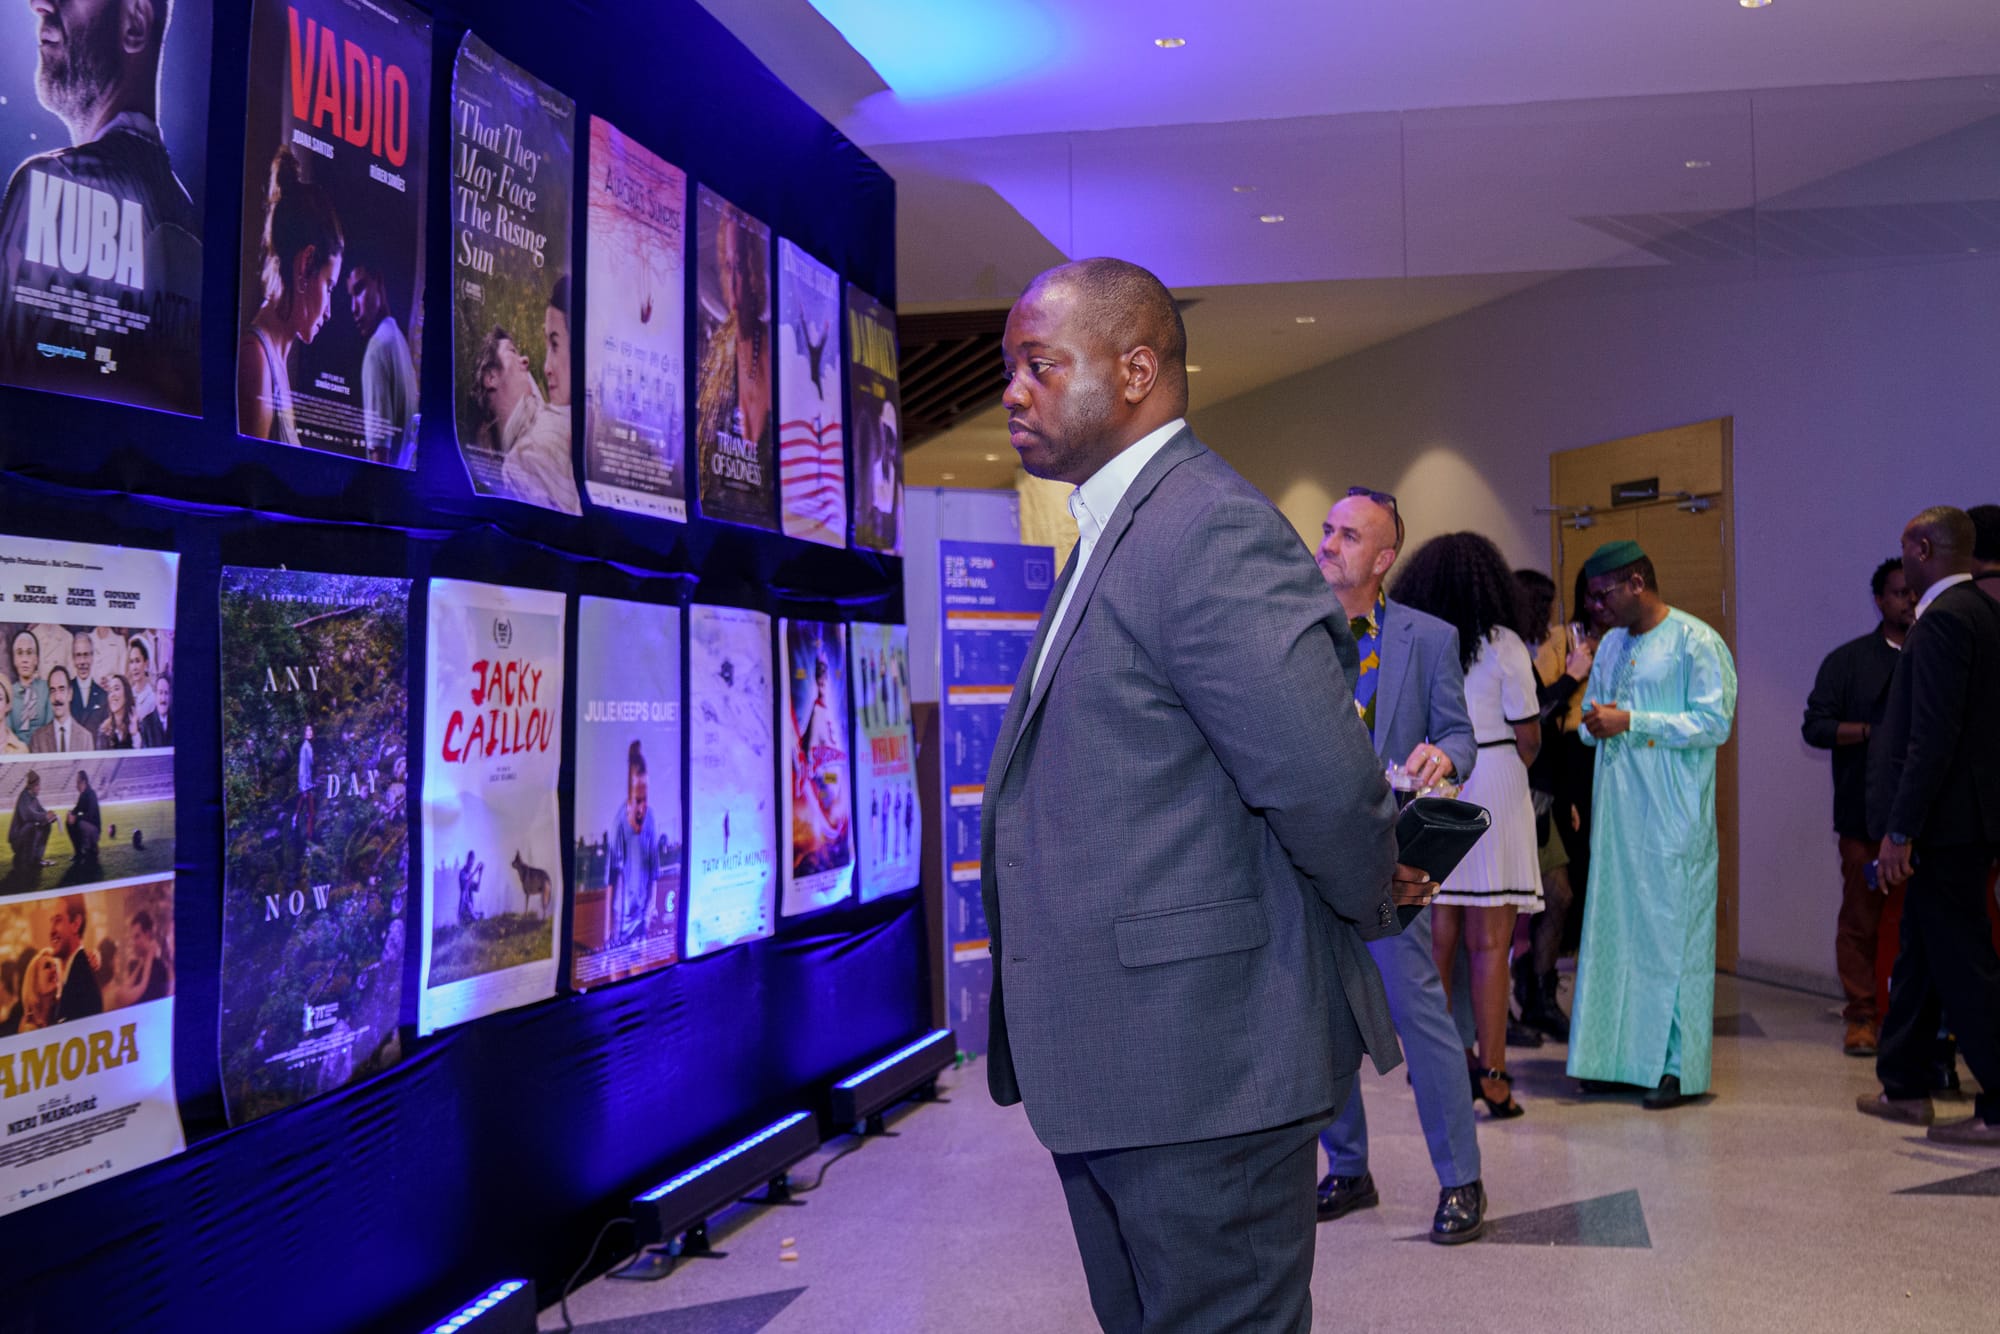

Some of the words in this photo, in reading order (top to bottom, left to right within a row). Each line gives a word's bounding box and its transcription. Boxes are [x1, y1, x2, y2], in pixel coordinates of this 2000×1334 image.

[288, 5, 409, 167] VADIO
[458, 100, 500, 153] That
[504, 123, 541, 183] They
[454, 143, 497, 201] May
[497, 164, 536, 213] Face
[25, 169, 144, 290] KUBA
[458, 186, 491, 233] The
[494, 203, 547, 268] Rising
[458, 230, 494, 276] Sun
[717, 431, 758, 462] TRIANGLE
[711, 453, 724, 475] OF
[725, 457, 761, 486] SADNESS
[24, 585, 47, 594] NERI
[104, 590, 141, 601] GIOVANNI
[263, 666, 320, 692] ANY
[471, 658, 542, 708] JACKY
[584, 700, 617, 722] JULIE
[617, 700, 650, 722] KEEPS
[651, 701, 680, 722] QUIET
[442, 707, 555, 764] CAILLOU
[326, 768, 379, 799] DAY
[264, 883, 331, 921] NOW
[7, 1115, 38, 1136] NERI
